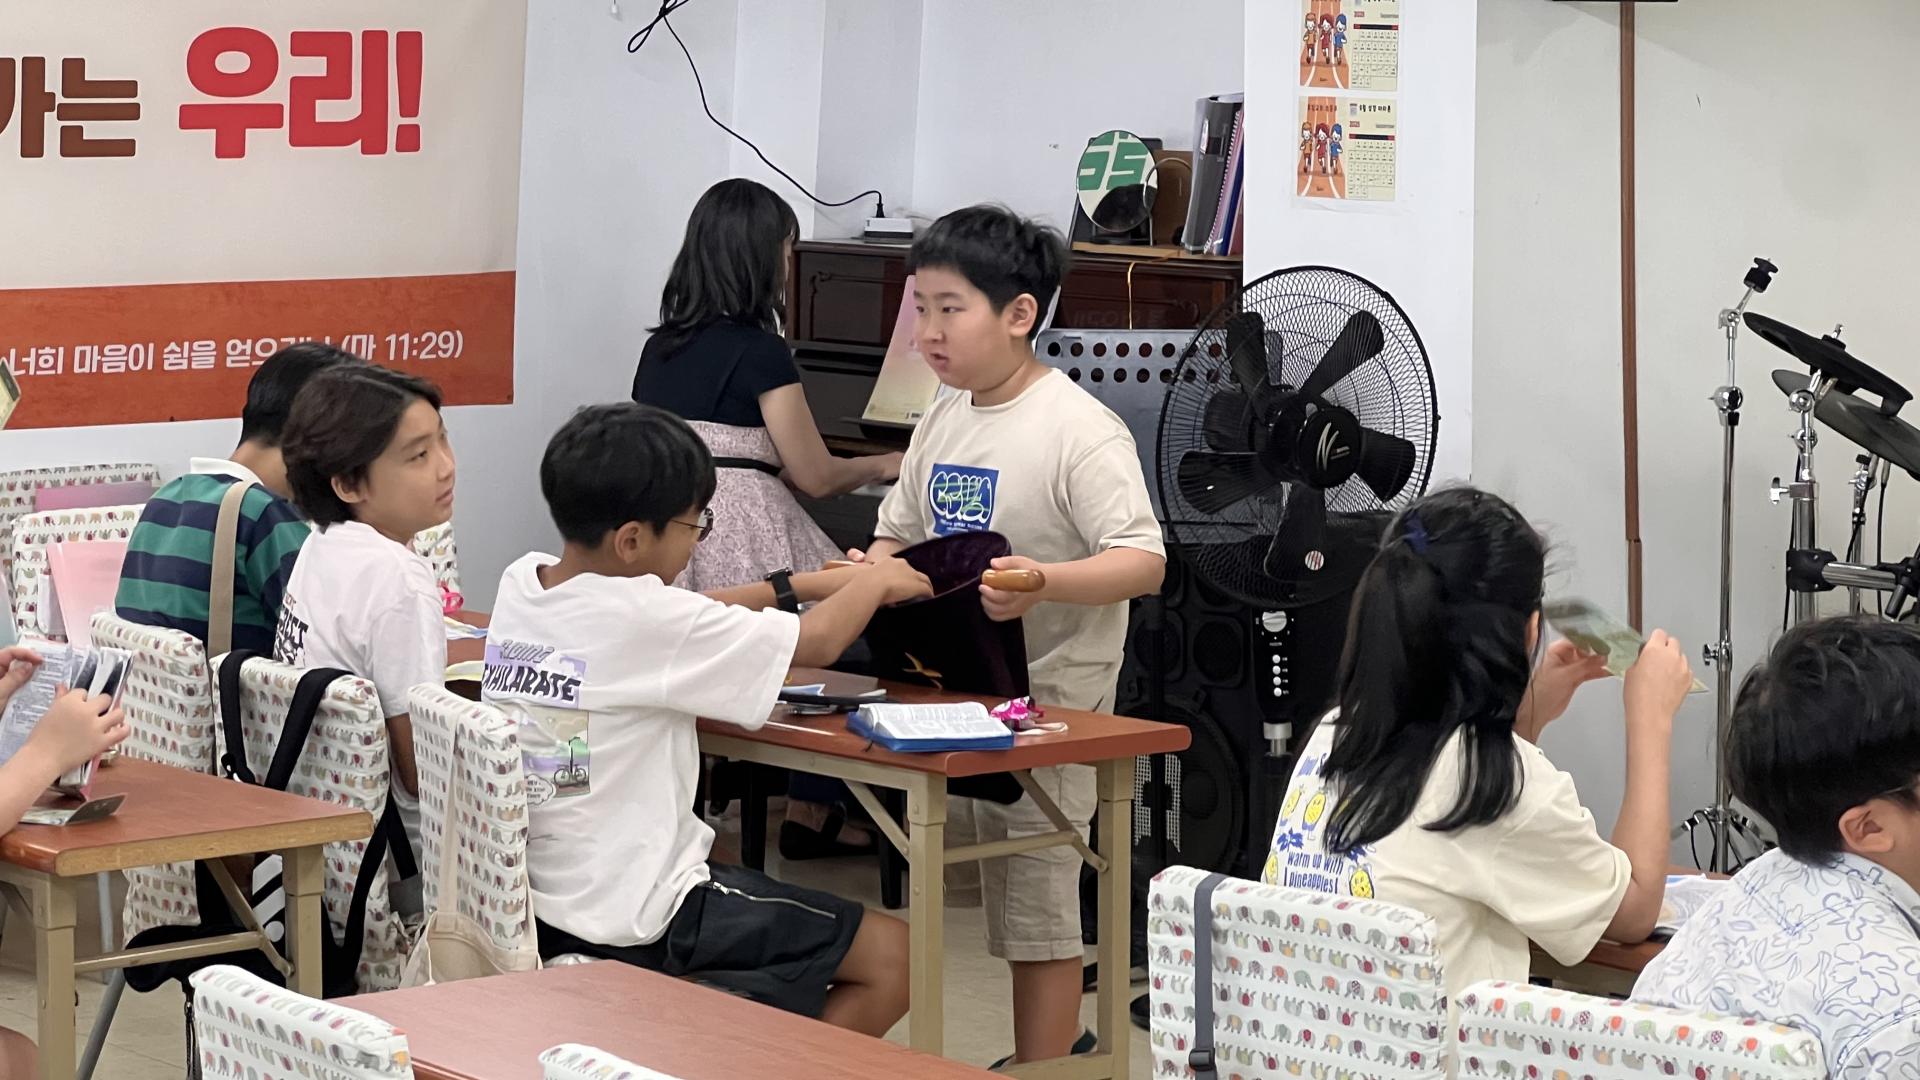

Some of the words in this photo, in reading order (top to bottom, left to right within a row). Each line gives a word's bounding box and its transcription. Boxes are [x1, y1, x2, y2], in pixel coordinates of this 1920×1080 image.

[178, 26, 424, 159] 우리!
[9, 346, 64, 376] 너희
[73, 342, 154, 374] 마음이
[162, 340, 217, 371] 쉼을
[226, 335, 330, 368] 얻으
[342, 333, 377, 361] (마
[385, 329, 464, 361] 11:29)
[1287, 851, 1311, 868] warm
[1312, 853, 1322, 870] up
[1323, 856, 1344, 876] with
